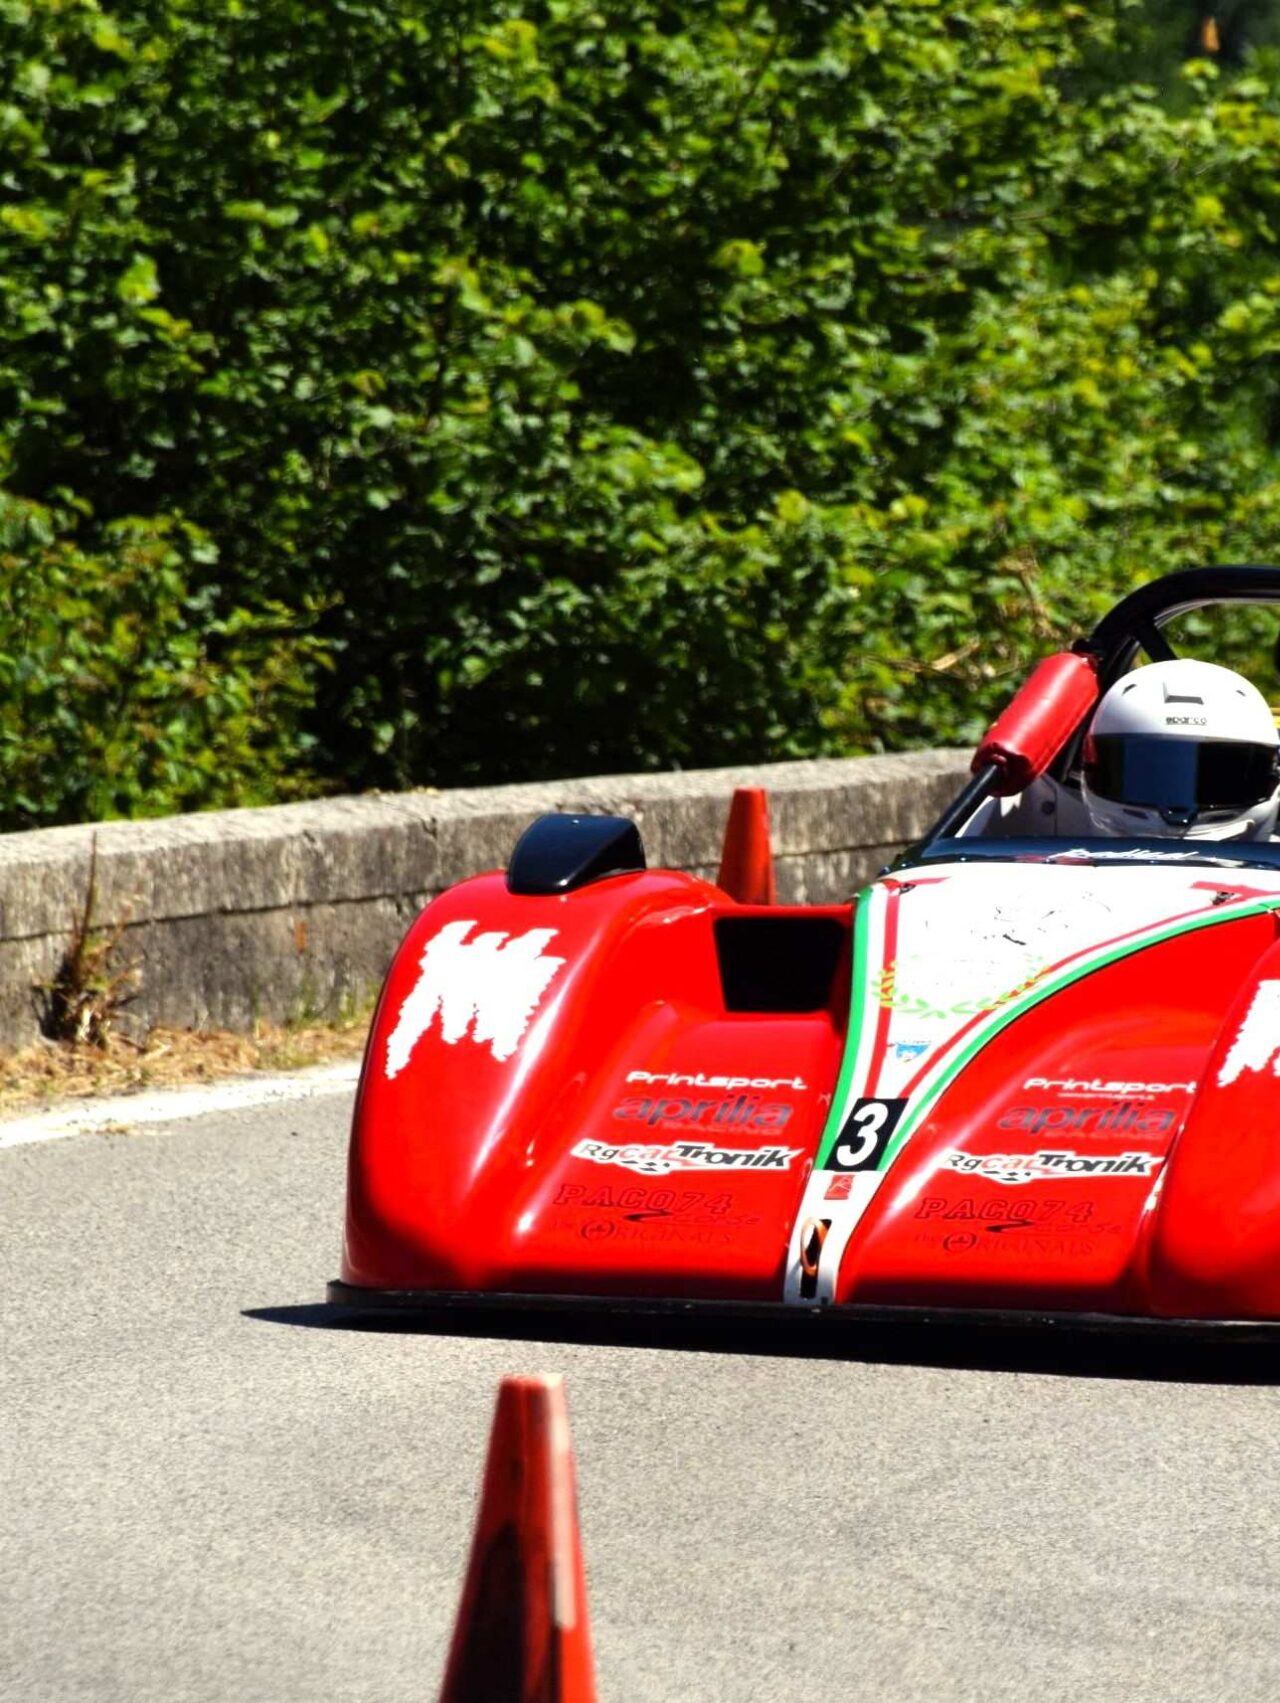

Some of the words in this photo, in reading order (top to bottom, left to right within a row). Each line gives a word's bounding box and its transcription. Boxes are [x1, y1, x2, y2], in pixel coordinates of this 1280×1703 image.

[626, 1071, 807, 1090] Printsport
[1024, 1077, 1198, 1095] Printsport
[612, 1095, 794, 1126] aprilia
[1000, 1101, 1177, 1134] aprilia
[837, 1102, 888, 1167] 3
